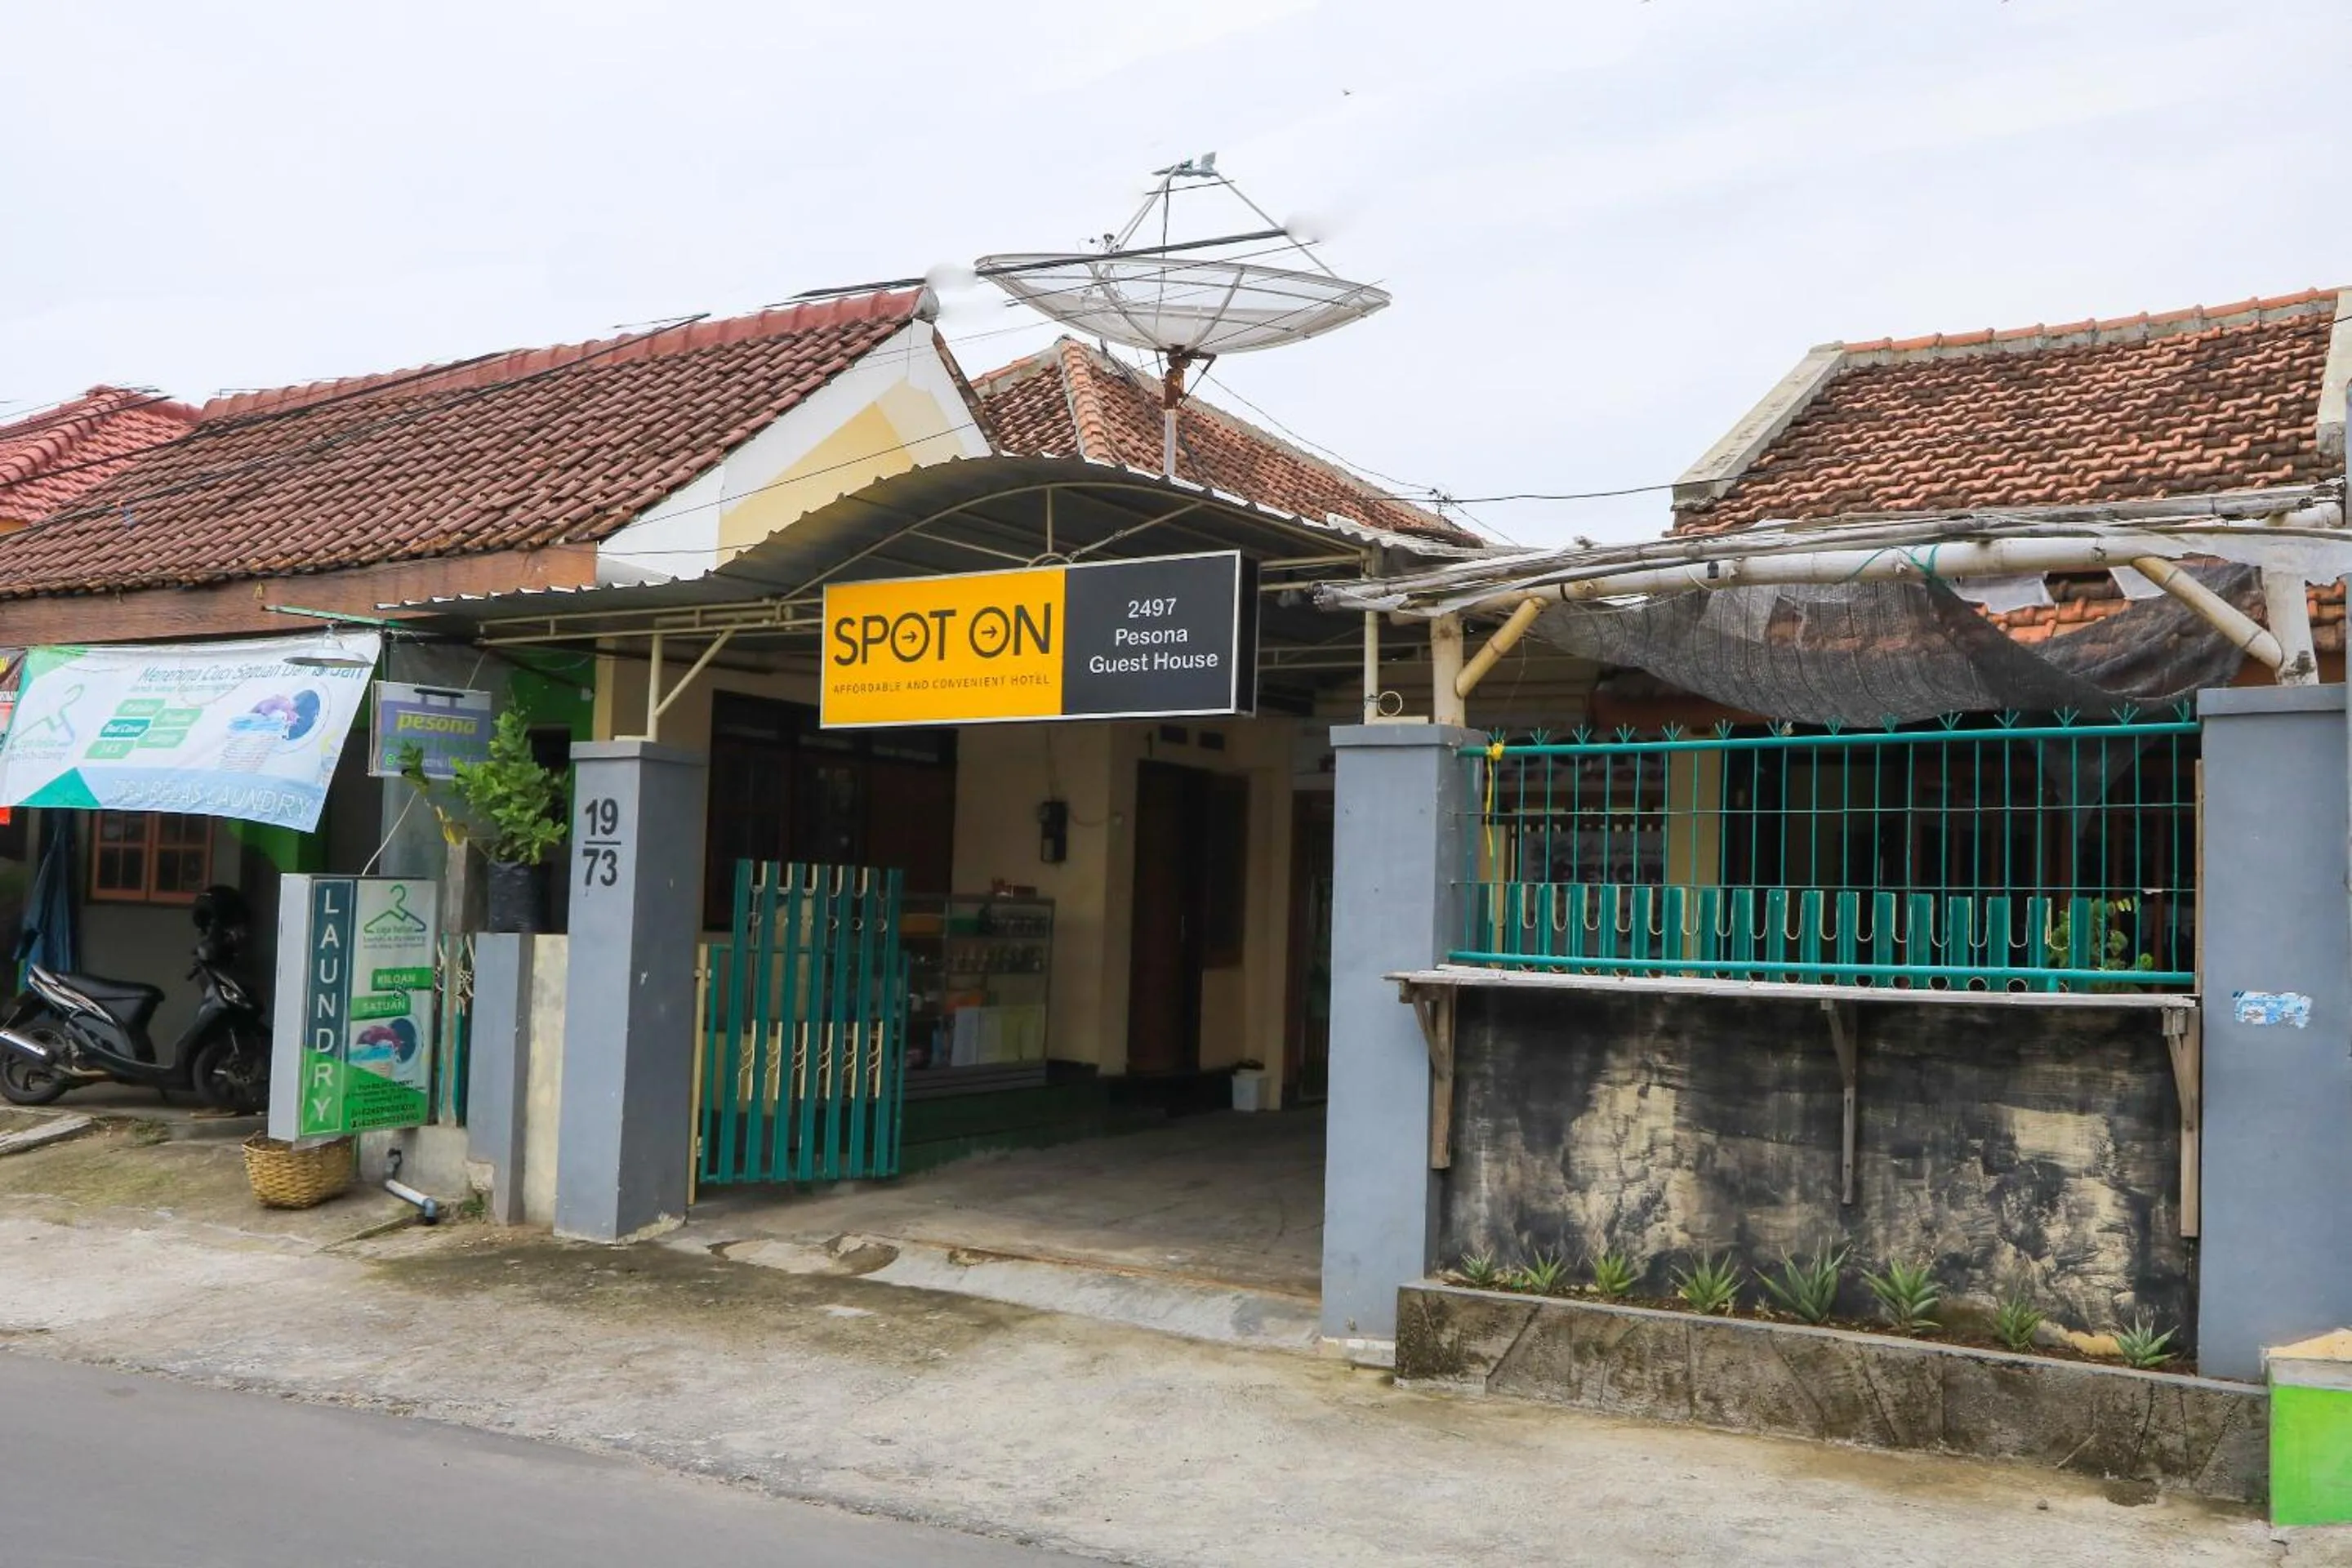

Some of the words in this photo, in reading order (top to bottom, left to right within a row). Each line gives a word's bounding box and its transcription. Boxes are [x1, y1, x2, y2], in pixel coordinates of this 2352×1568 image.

[1127, 597, 1178, 619] 2497
[833, 608, 957, 666] SPOT
[969, 603, 1052, 659] ON
[1114, 627, 1189, 647] Pesona
[1089, 654, 1149, 675] Guest
[1152, 652, 1218, 670] House
[833, 679, 902, 695] AFFORDABLE
[906, 678, 929, 691] AND
[932, 675, 1006, 690] CONVENIENT
[1010, 673, 1051, 686] HOTEL
[397, 713, 478, 734] pesona
[206, 782, 312, 817] LAUNDRY
[585, 797, 619, 836] 19
[582, 848, 618, 887] 73
[313, 889, 340, 1122] LAUNDRY
